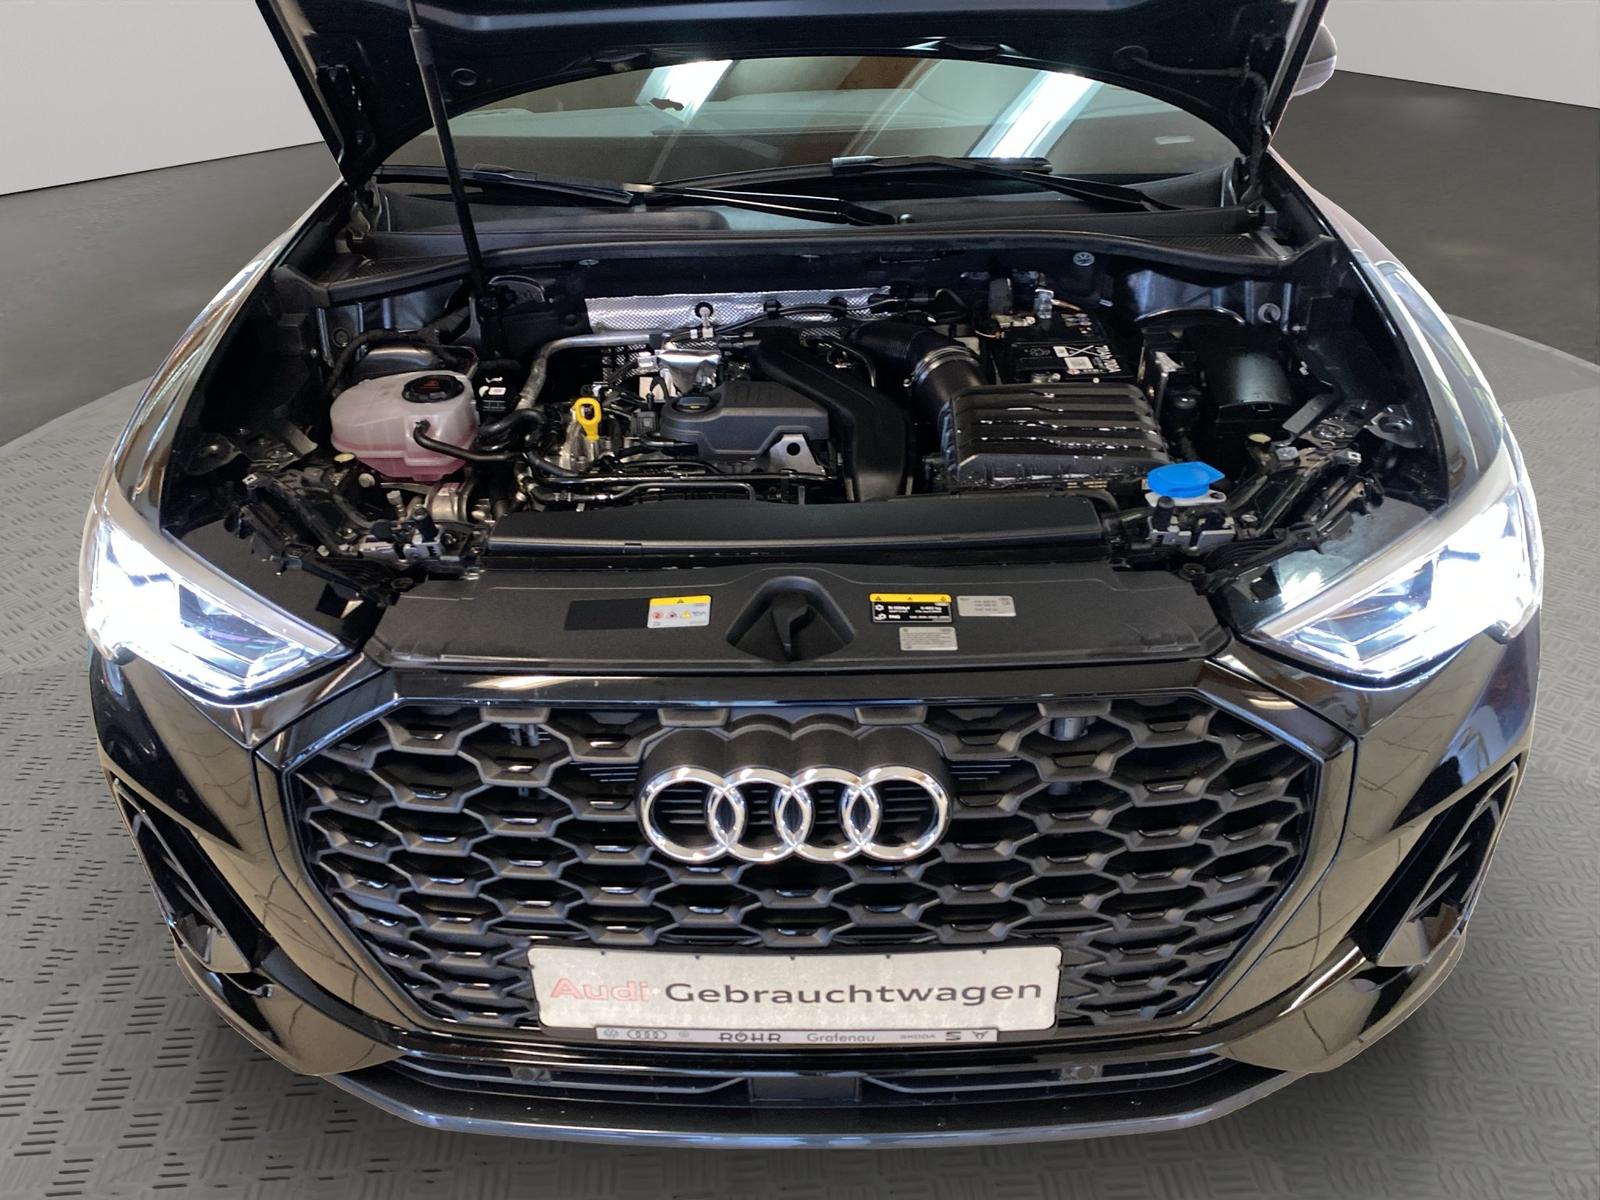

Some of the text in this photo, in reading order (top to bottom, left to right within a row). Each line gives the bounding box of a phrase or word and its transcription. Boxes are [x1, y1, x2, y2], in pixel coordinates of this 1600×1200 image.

[550, 977, 1042, 1006] Audi Gebrauchtwagen
[806, 1032, 876, 1043] Grafenau
